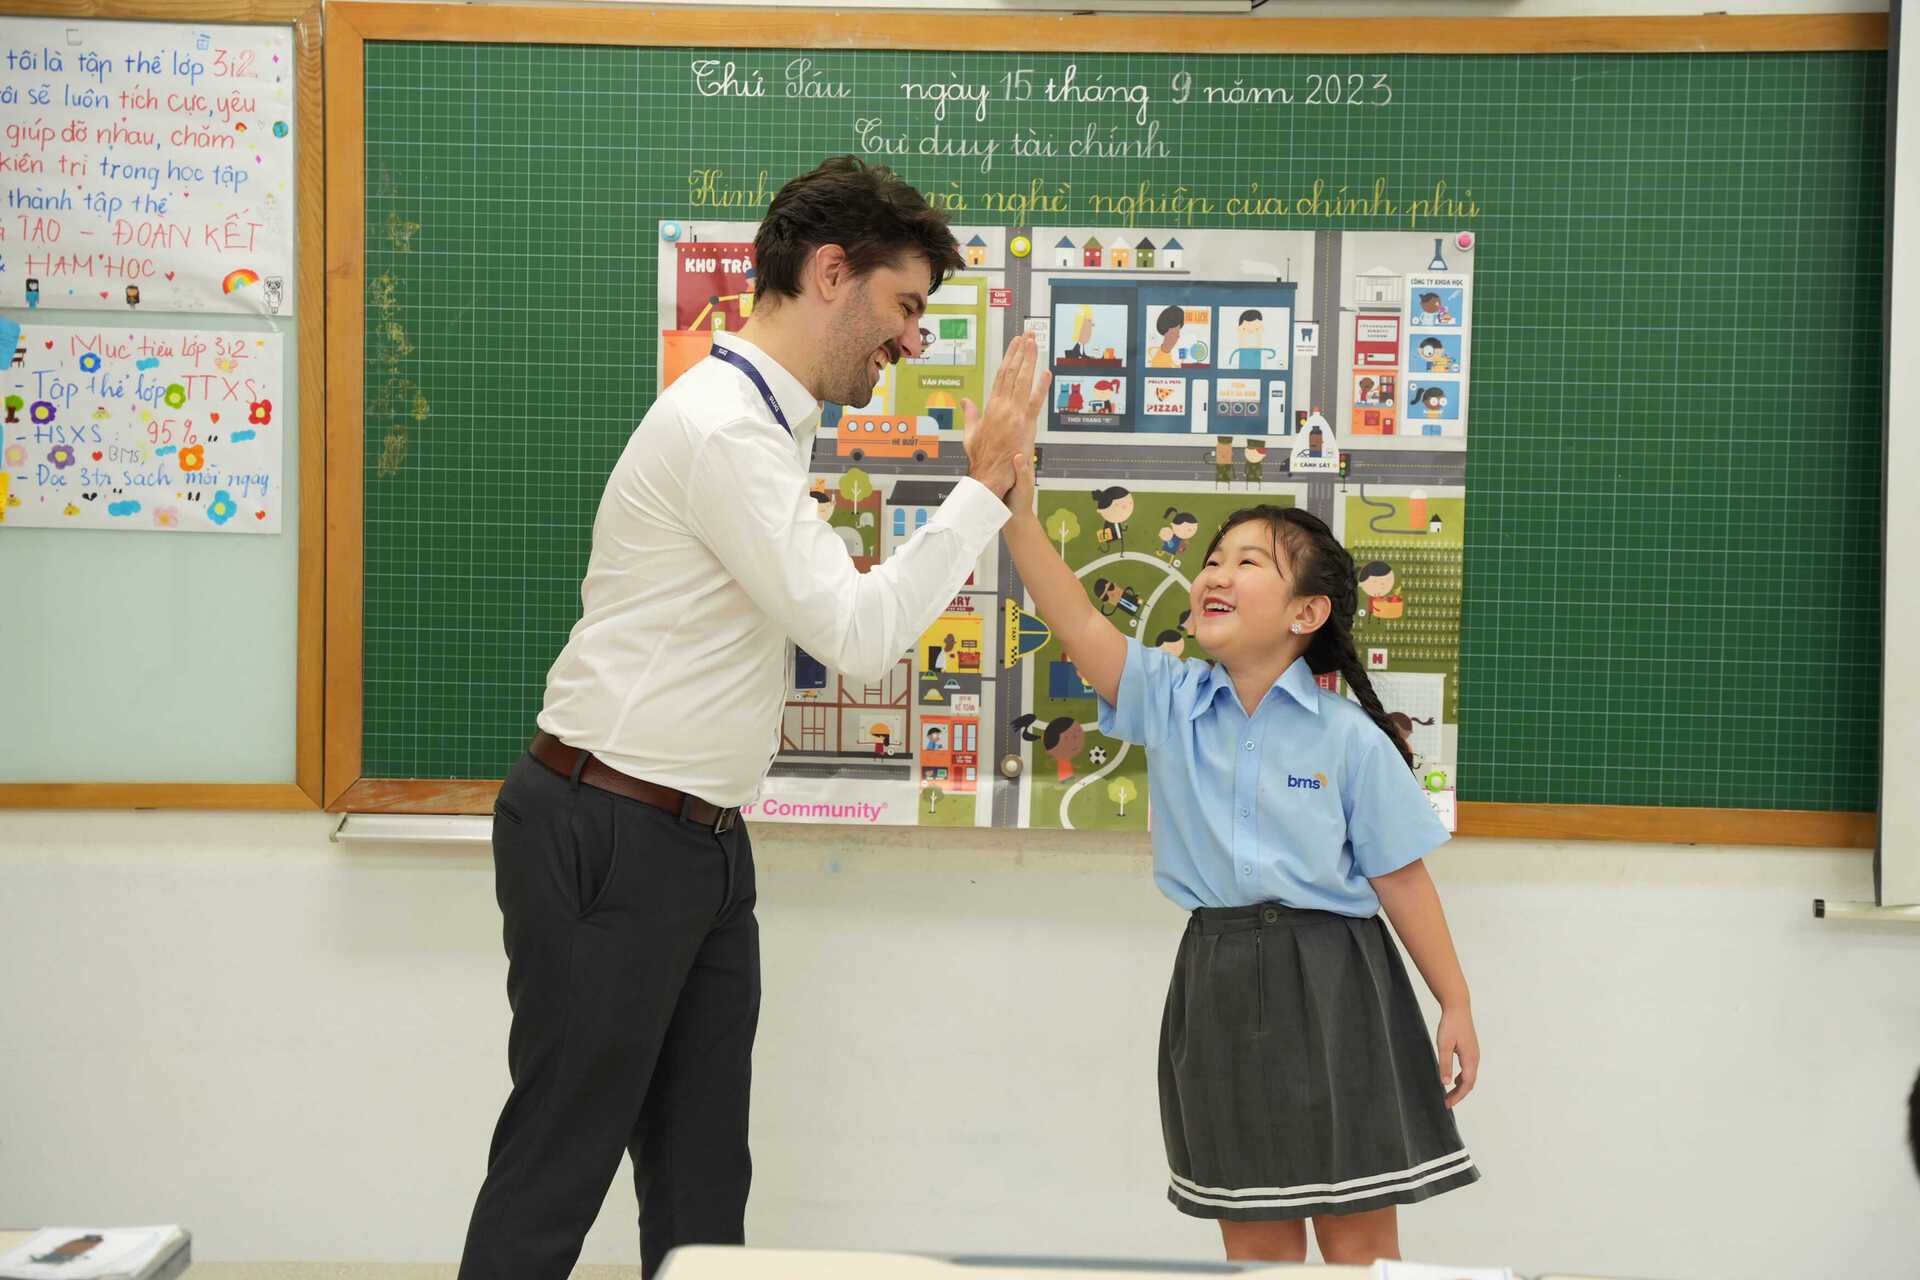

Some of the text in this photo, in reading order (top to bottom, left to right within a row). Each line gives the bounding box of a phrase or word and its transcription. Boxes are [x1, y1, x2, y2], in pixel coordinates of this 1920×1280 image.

[6, 48, 37, 71] tôi
[44, 48, 63, 72] là
[78, 51, 112, 84] tập
[173, 50, 204, 86] lớp
[0, 85, 18, 105] ôi
[28, 83, 51, 105] sẽ
[64, 83, 109, 108] luôn
[119, 84, 159, 110] tích
[216, 90, 256, 124] yêu
[691, 58, 1393, 126] Thứ Sáu ngày 15 tháng 9 năm 2023
[6, 117, 56, 152] giúp
[61, 119, 88, 142] đỡ
[171, 124, 235, 149] chăm
[855, 117, 1171, 174] Tư duy tài chính
[100, 156, 160, 191] trong
[213, 164, 249, 193] tập
[8, 187, 72, 210] thành
[981, 177, 1072, 228] nghề
[1088, 179, 1215, 229] nghiệp
[1227, 182, 1289, 216] của
[1296, 177, 1398, 218] chính
[1405, 179, 1481, 229] phủ
[205, 208, 264, 253] KẾT
[685, 257, 717, 273] KHU
[1146, 404, 1183, 413] PIZZA!
[1287, 774, 1321, 790] bms
